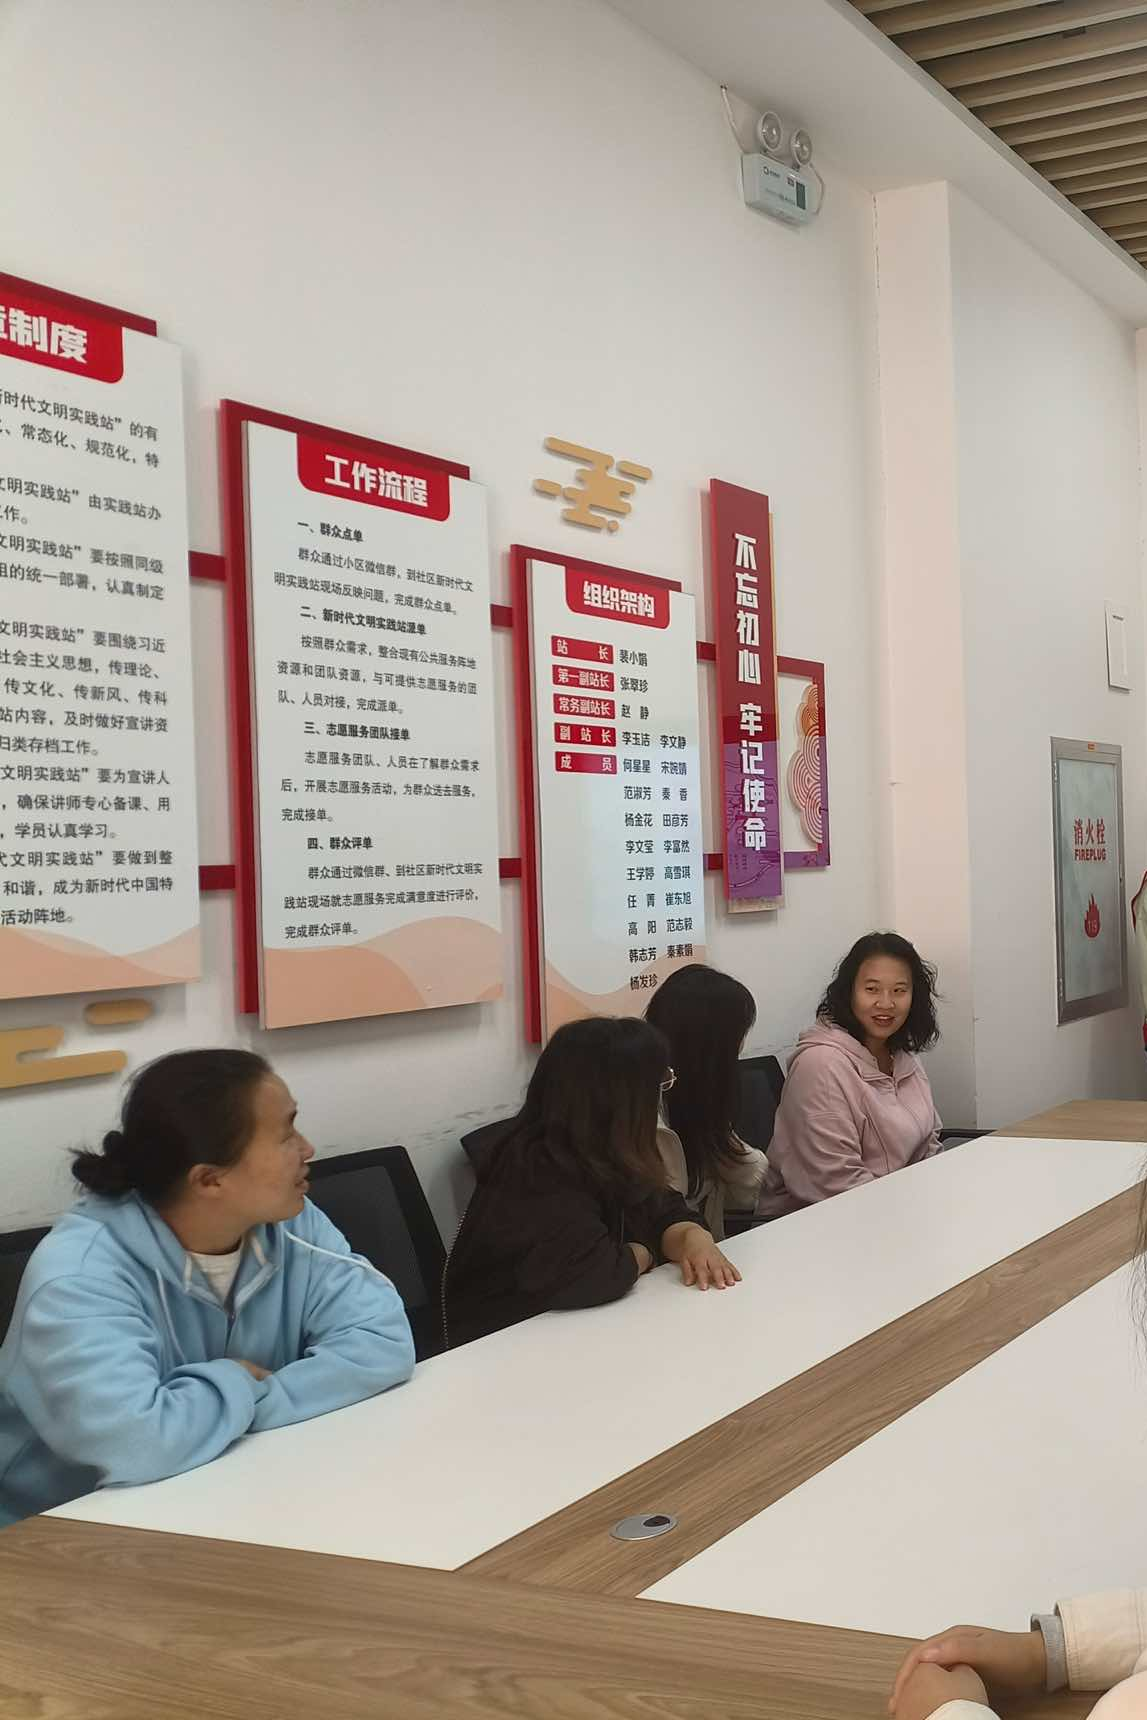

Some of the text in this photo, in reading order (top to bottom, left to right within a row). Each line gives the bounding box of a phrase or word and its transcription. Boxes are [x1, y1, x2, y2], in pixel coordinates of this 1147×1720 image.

[0, 305, 88, 364] 制度
[0, 388, 158, 441] 时代文明实践站”的有
[325, 454, 429, 507] 工作流程
[0, 504, 28, 525] 作。
[297, 521, 364, 542] 一、群众点单
[582, 580, 656, 618] 组织架构
[732, 532, 762, 686] 不忘初心
[557, 667, 609, 687] 第一副站长
[559, 696, 611, 716] 常务副站长
[304, 720, 411, 741] 三、志愿服务团队接单
[560, 754, 613, 772] 成员
[739, 702, 766, 852] 牢记使命
[624, 813, 653, 827] 杨金花
[1073, 818, 1106, 846] 消火栓
[307, 836, 373, 850] 四、群众评单
[1074, 848, 1107, 861] FIREPLUG
[628, 920, 657, 936] 高阳
